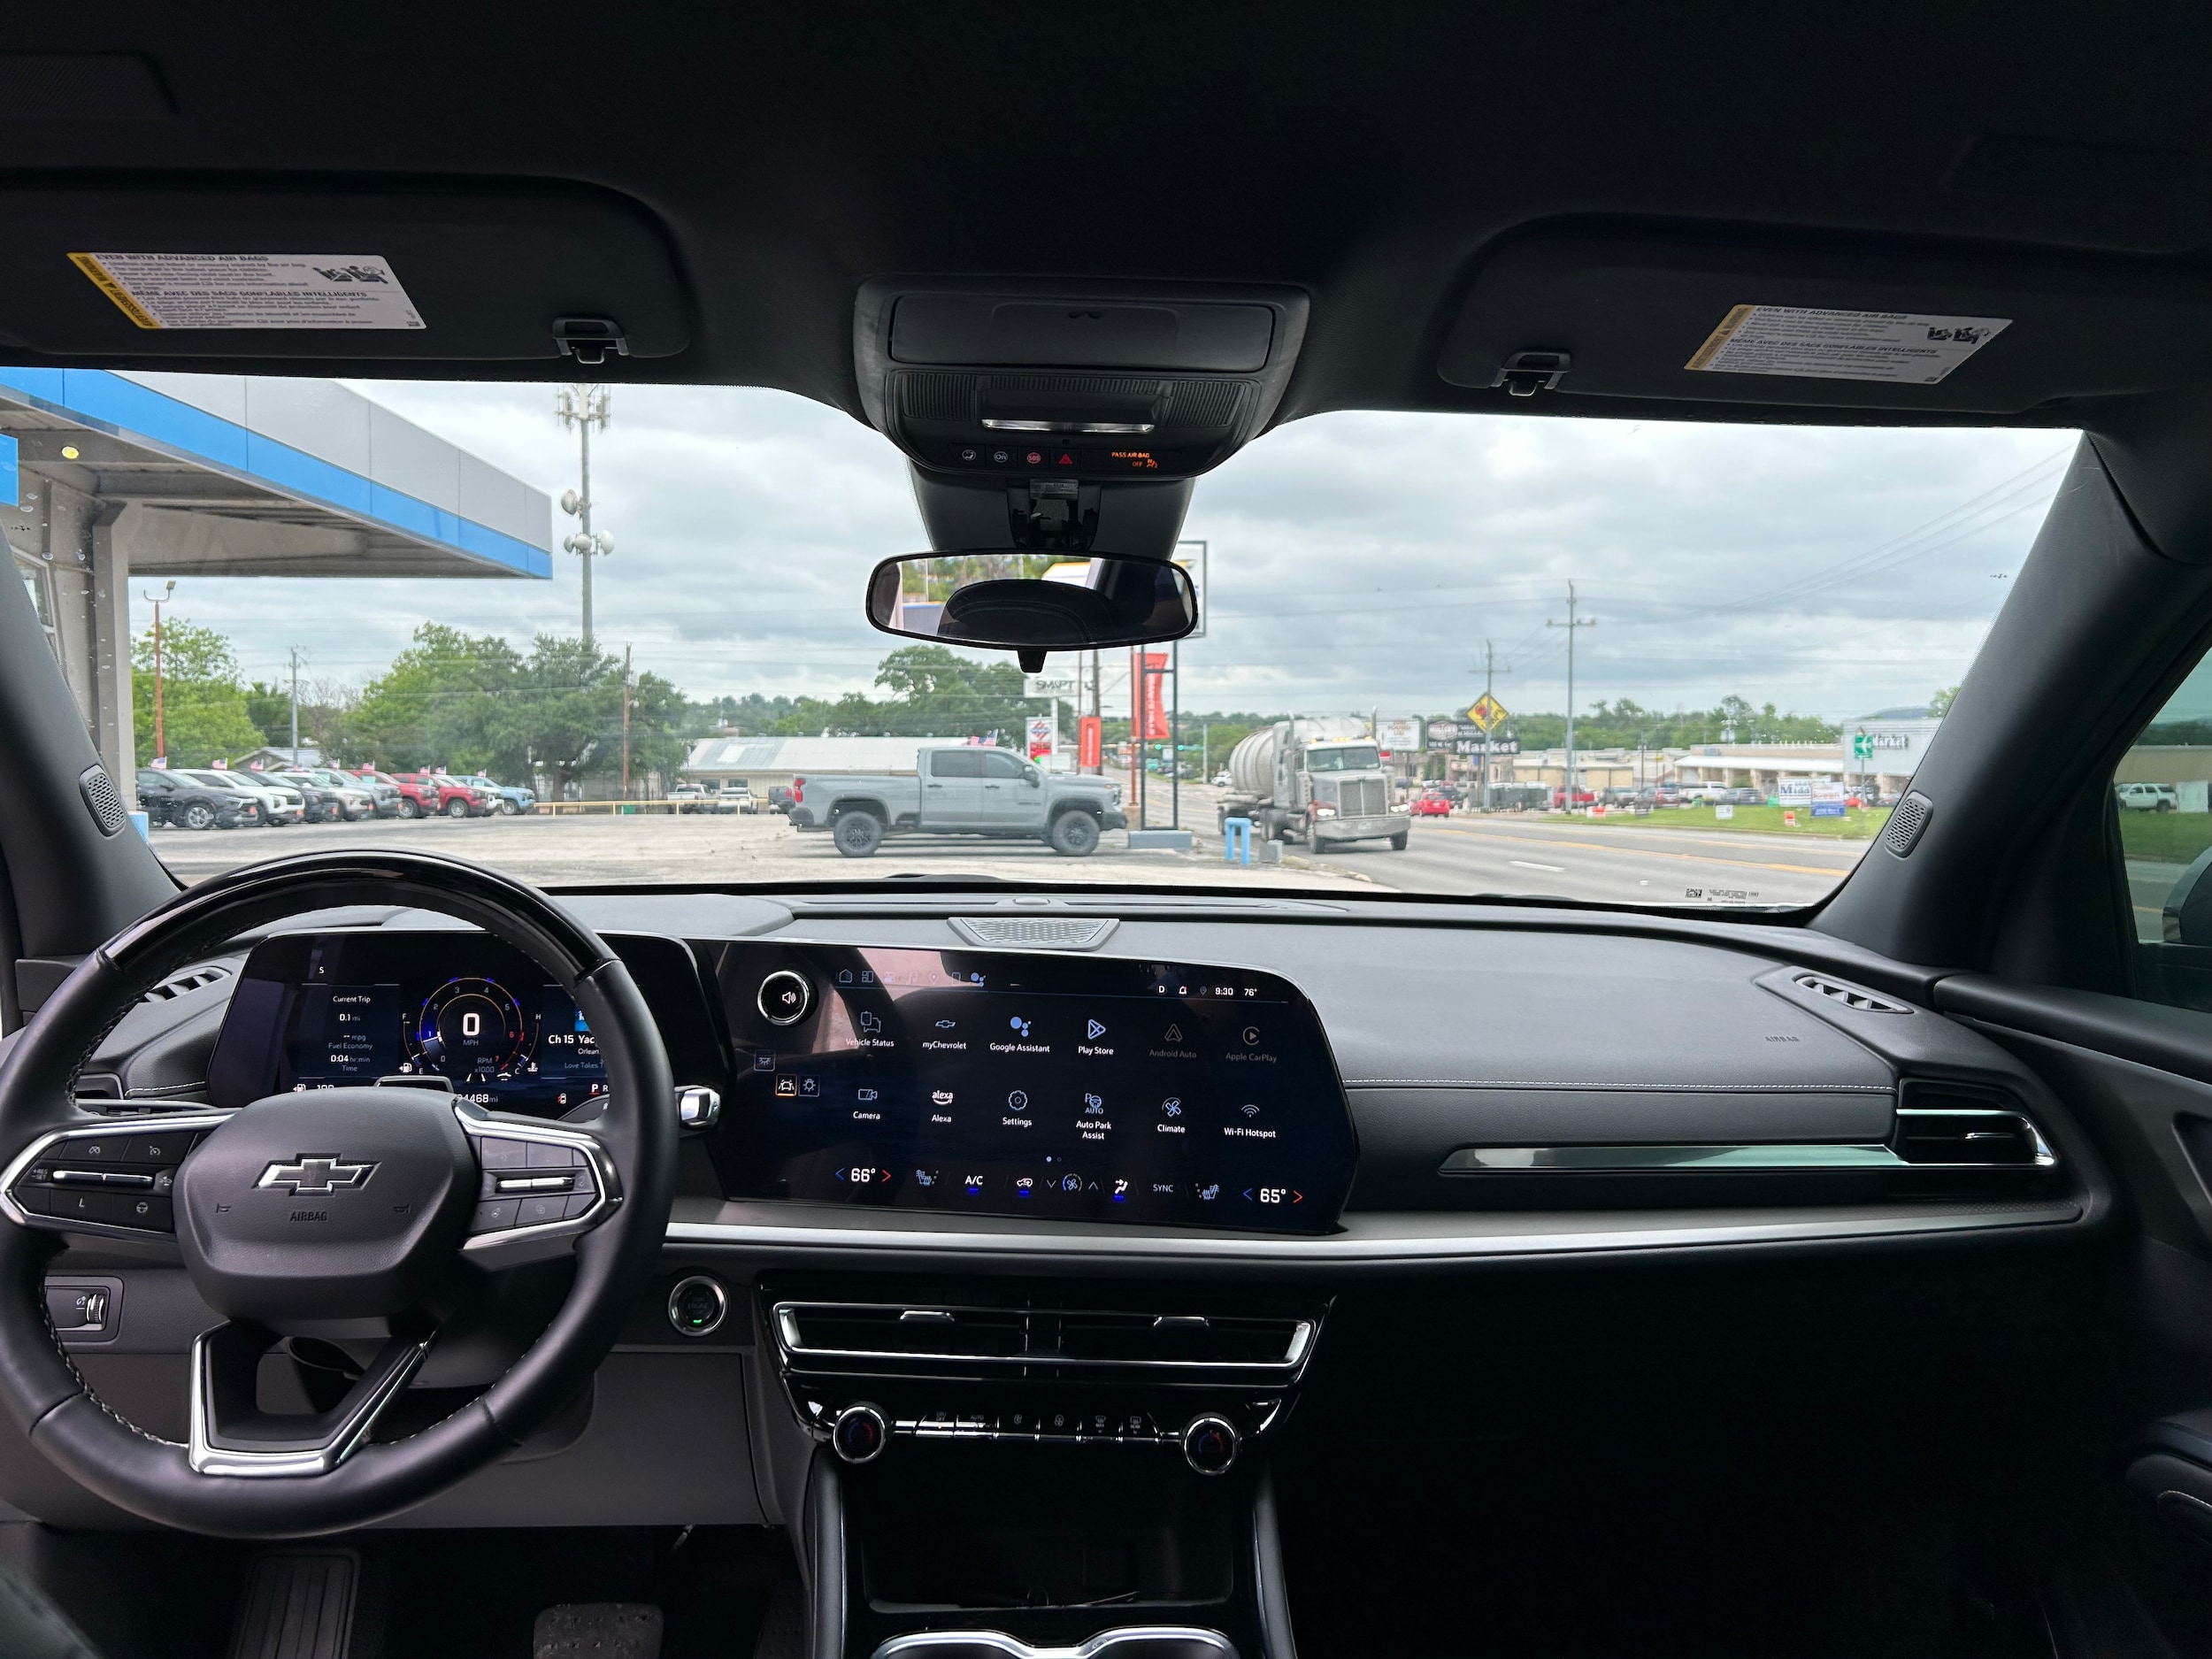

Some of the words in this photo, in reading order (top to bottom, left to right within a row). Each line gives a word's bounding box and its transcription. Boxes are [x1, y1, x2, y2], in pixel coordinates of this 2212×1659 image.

[1456, 741, 1518, 753] Market
[1215, 987, 1233, 996] 9:30
[1244, 987, 1257, 996] 76°
[357, 995, 372, 1004] Trip
[463, 1012, 480, 1036] 0
[549, 1034, 562, 1044] Ch
[564, 1034, 574, 1044] 15
[578, 1034, 595, 1044] Yac
[846, 1038, 870, 1047] Vehicle
[872, 1039, 895, 1048] Status
[922, 1041, 966, 1050] myChevrolet
[989, 1042, 1016, 1053] Google
[1017, 1043, 1050, 1053] Assistant
[1078, 1046, 1093, 1056] Play
[1094, 1047, 1114, 1056] Store
[1149, 1048, 1178, 1058] Android
[1179, 1049, 1197, 1058] Auto
[1225, 1052, 1248, 1062] Apple
[1248, 1053, 1277, 1064] CarPlay
[591, 1083, 599, 1093] P
[853, 1110, 880, 1120] Camera
[932, 1114, 952, 1123] Alexa
[1002, 1117, 1033, 1128] Settings
[1076, 1120, 1094, 1130] Auto
[1094, 1121, 1111, 1131] Park
[1157, 1124, 1186, 1133] Climate
[1224, 1127, 1244, 1137] Wi-Fi
[1245, 1128, 1276, 1139] Hotspot
[1082, 1131, 1105, 1140] Assist
[850, 1167, 876, 1183] 66°
[964, 1174, 983, 1186] A/C
[1153, 1183, 1174, 1193] SYNC
[1259, 1188, 1286, 1203] 65°
[290, 1211, 327, 1222] AIRBAG
